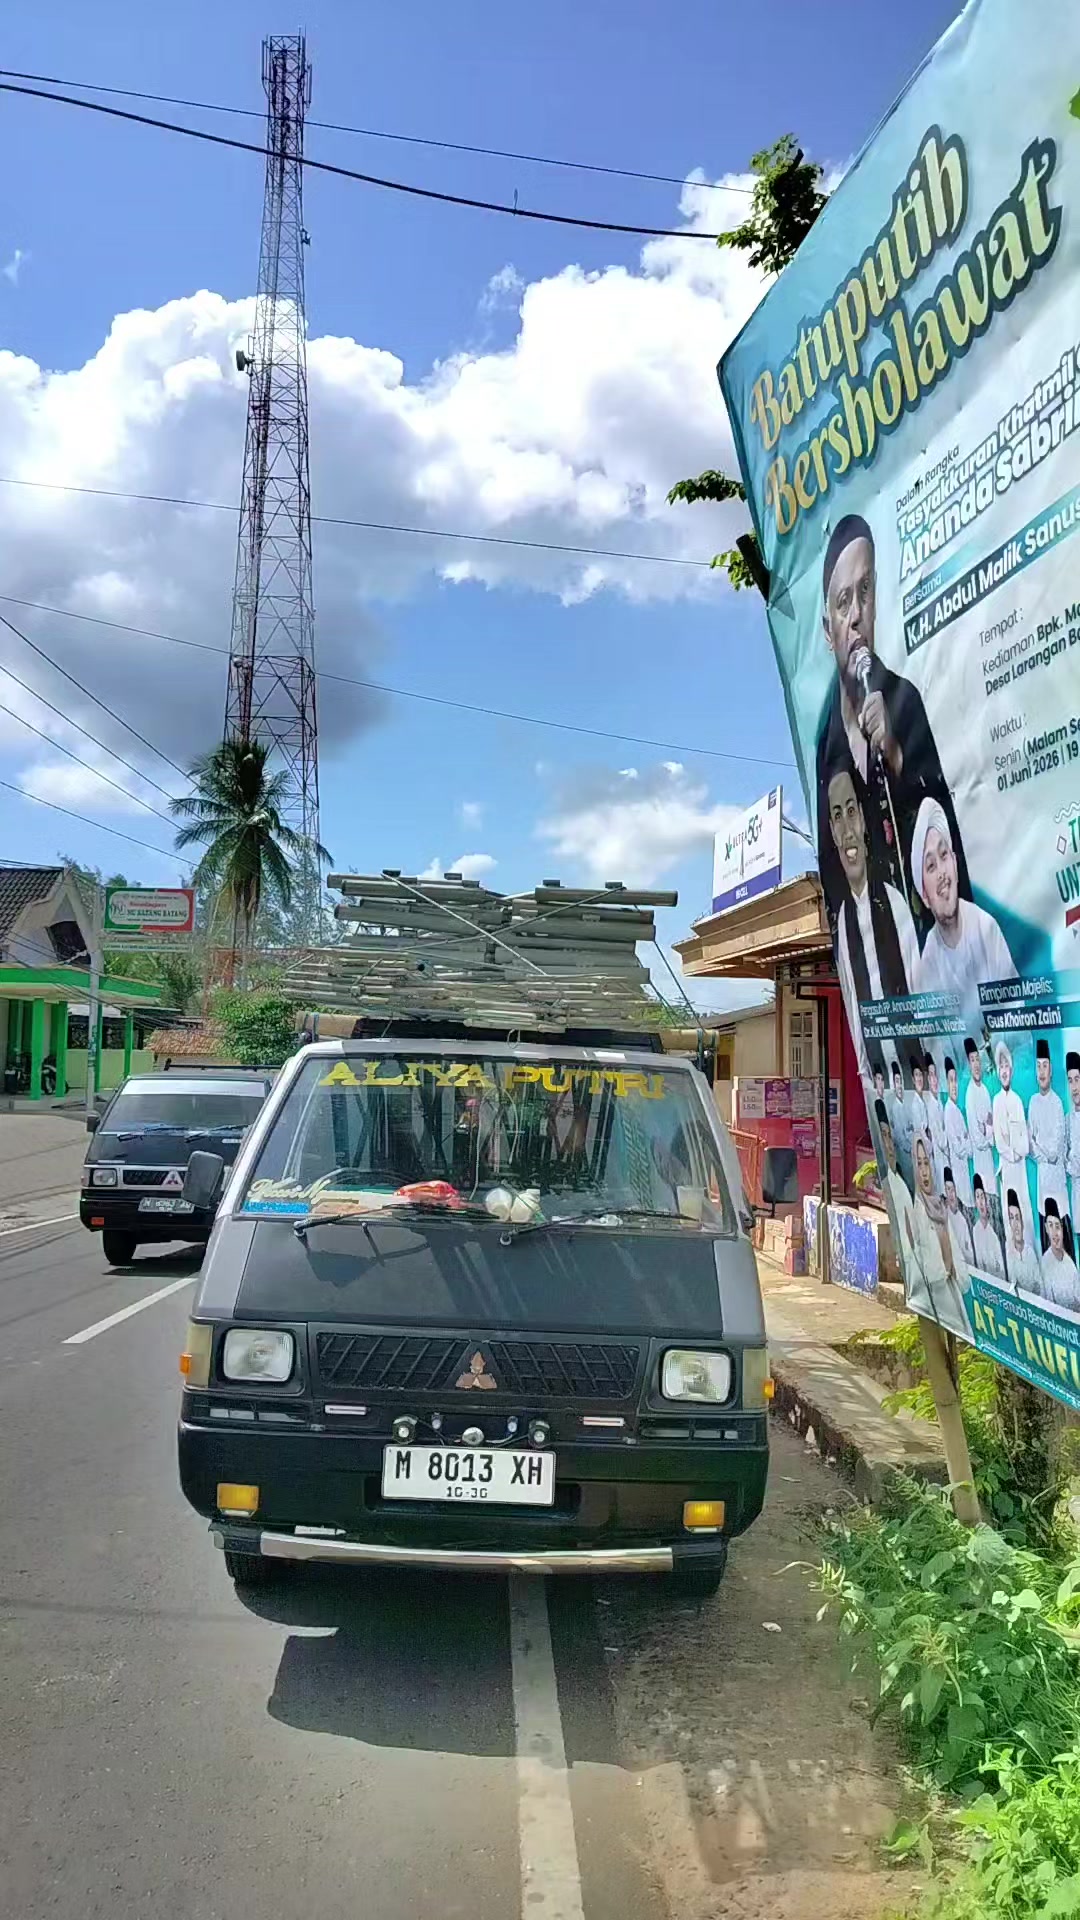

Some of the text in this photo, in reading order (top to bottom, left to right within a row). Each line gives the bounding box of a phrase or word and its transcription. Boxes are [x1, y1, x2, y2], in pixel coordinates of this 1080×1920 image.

[751, 132, 966, 452] Batuputih
[764, 146, 1058, 535] Bersholawat
[897, 346, 1075, 537] Tasyakkuran Khatmil
[896, 445, 960, 512] Dalam Rangka
[900, 467, 995, 581] Ananda
[904, 572, 943, 610] Bersama
[906, 613, 932, 648] K.H.
[934, 574, 978, 628] Abdul
[978, 541, 1024, 593] Malik
[982, 634, 1035, 676] Kediaman
[1036, 616, 1063, 643] Bpk.
[985, 671, 1011, 697] Desa
[1011, 637, 1067, 681] Larangan
[994, 747, 1021, 772] Senin
[1023, 726, 1068, 761] (Malam
[997, 774, 1008, 792] 01
[1009, 762, 1032, 787] Juni
[1032, 750, 1060, 776] 2026
[980, 982, 1022, 1002] Pimpinan
[987, 1006, 1062, 1028] Gus Khoiron Zaini
[503, 1066, 665, 1099] PUTRI
[395, 1450, 543, 1486] M 8013 XH
